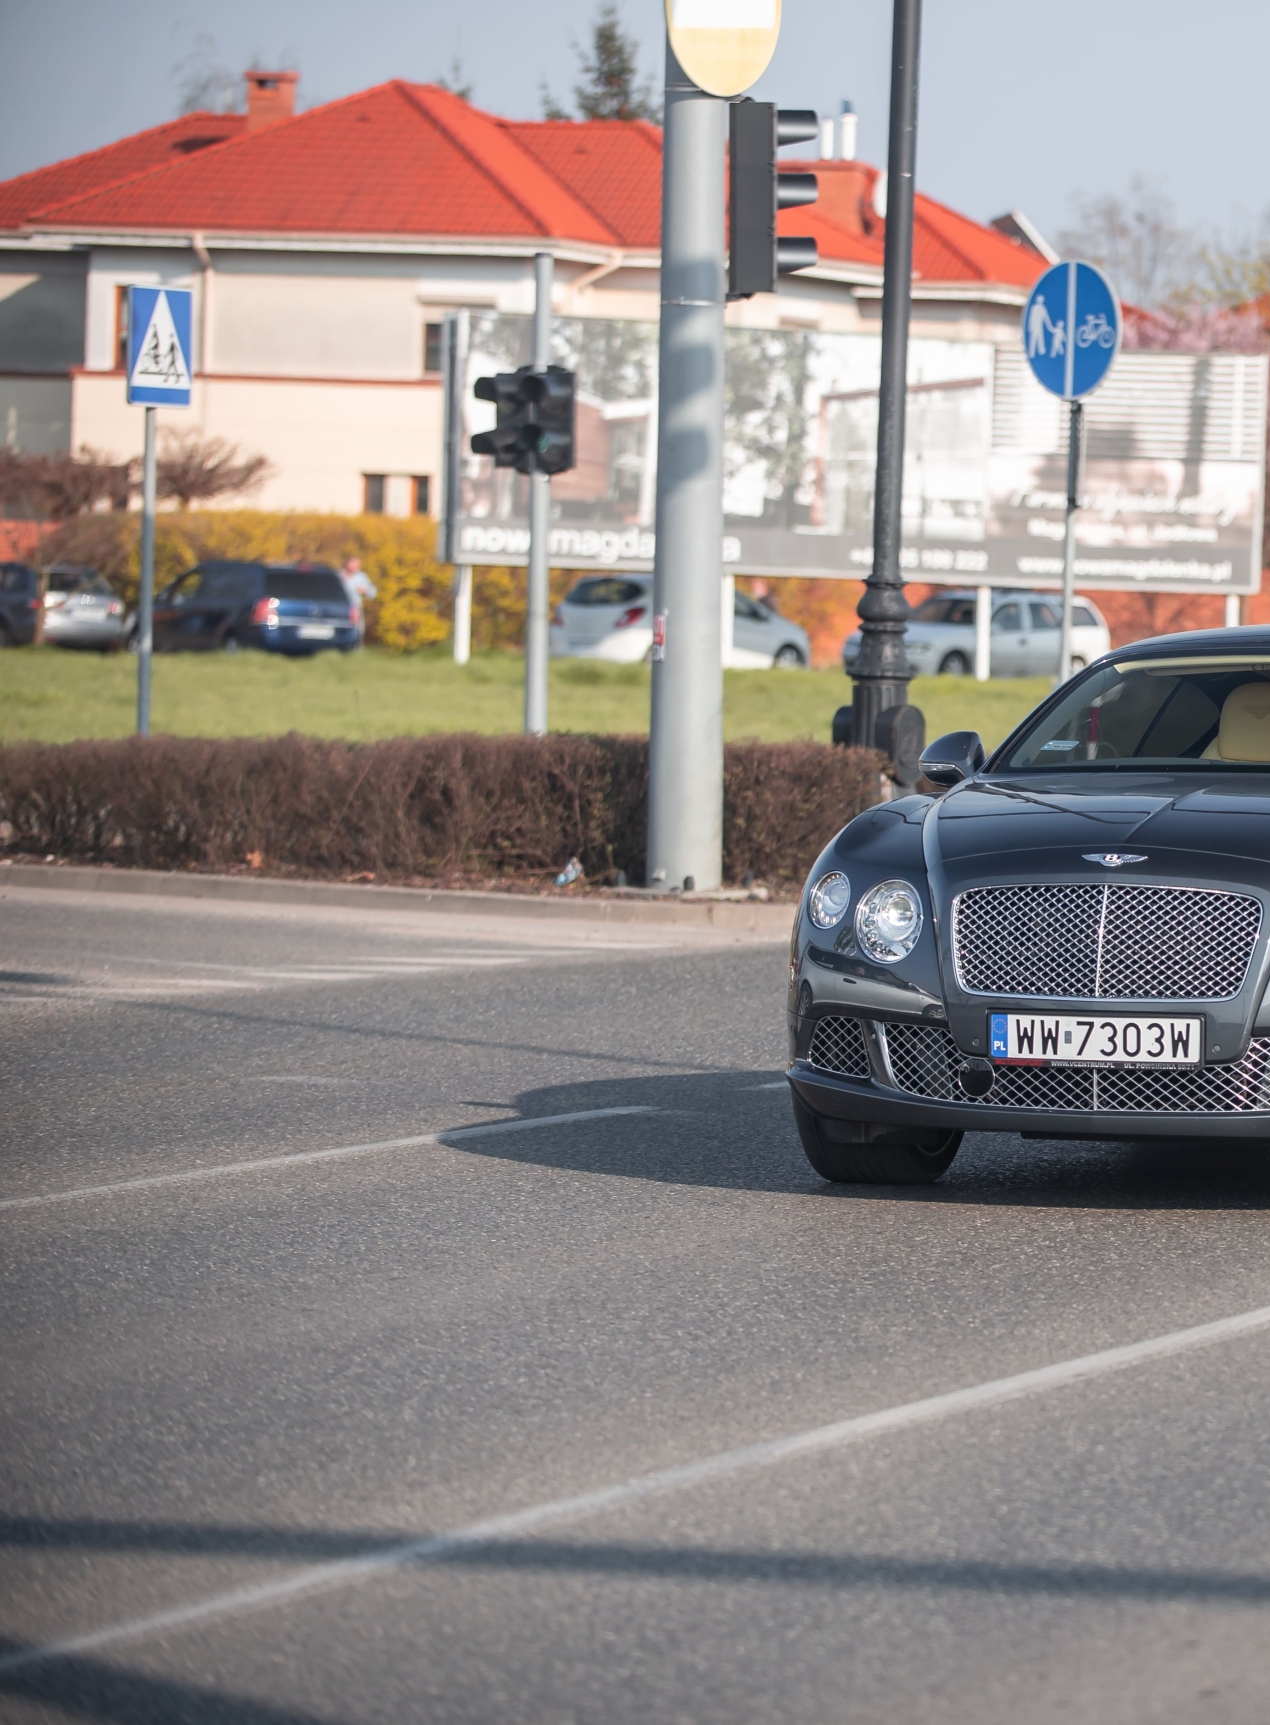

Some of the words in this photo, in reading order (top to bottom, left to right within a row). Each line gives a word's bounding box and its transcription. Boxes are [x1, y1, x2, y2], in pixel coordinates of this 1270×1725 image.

[1015, 1018, 1060, 1056] WW
[1076, 1020, 1191, 1059] 7303W
[993, 1040, 1007, 1052] PL
[994, 1058, 1044, 1067] MOTORSPORT
[1050, 1060, 1116, 1069] WWW.VCENTRUM.PL
